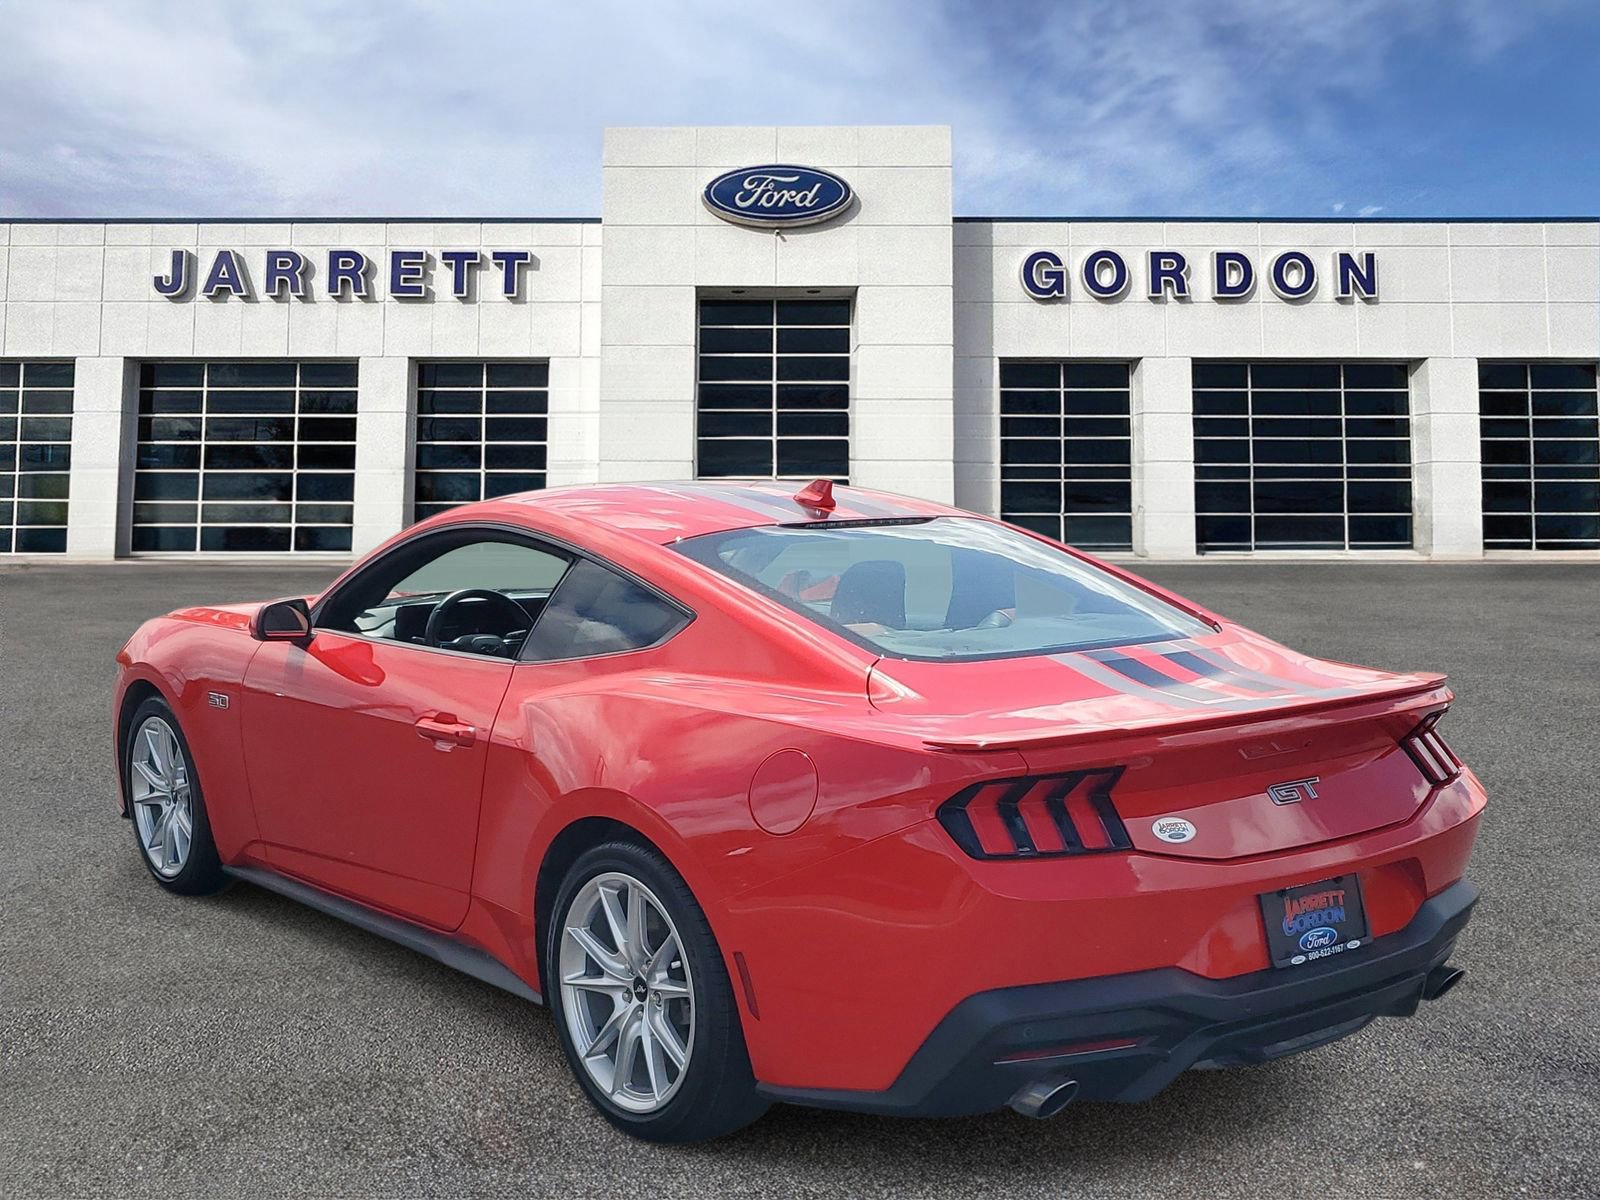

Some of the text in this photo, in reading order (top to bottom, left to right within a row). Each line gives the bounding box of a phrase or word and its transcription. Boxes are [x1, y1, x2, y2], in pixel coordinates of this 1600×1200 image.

[735, 174, 821, 208] Ford
[153, 248, 1378, 299] JARRETT GORDON
[1267, 777, 1319, 806] GT
[1283, 907, 1346, 936] GORDON
[1284, 890, 1345, 926] JARRETT
[1306, 931, 1331, 949] Ford
